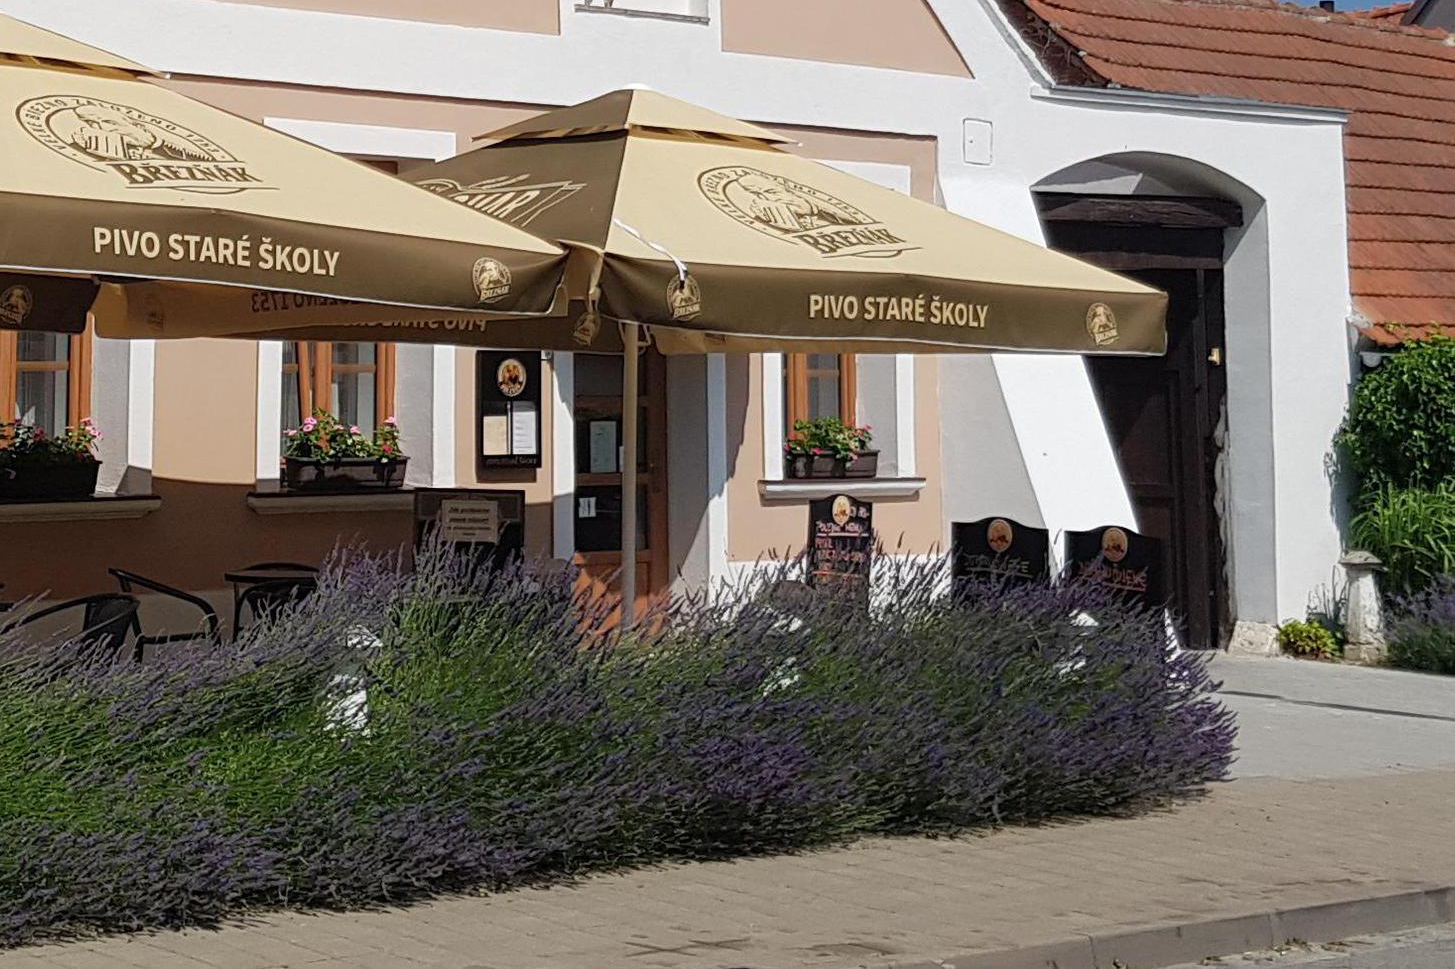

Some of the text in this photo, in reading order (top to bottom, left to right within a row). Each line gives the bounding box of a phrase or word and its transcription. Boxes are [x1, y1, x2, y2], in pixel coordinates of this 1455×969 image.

[93, 226, 341, 277] PIVO STARÉ ŠKOLY
[808, 293, 989, 329] PIVO STARÉ ŠKOLY
